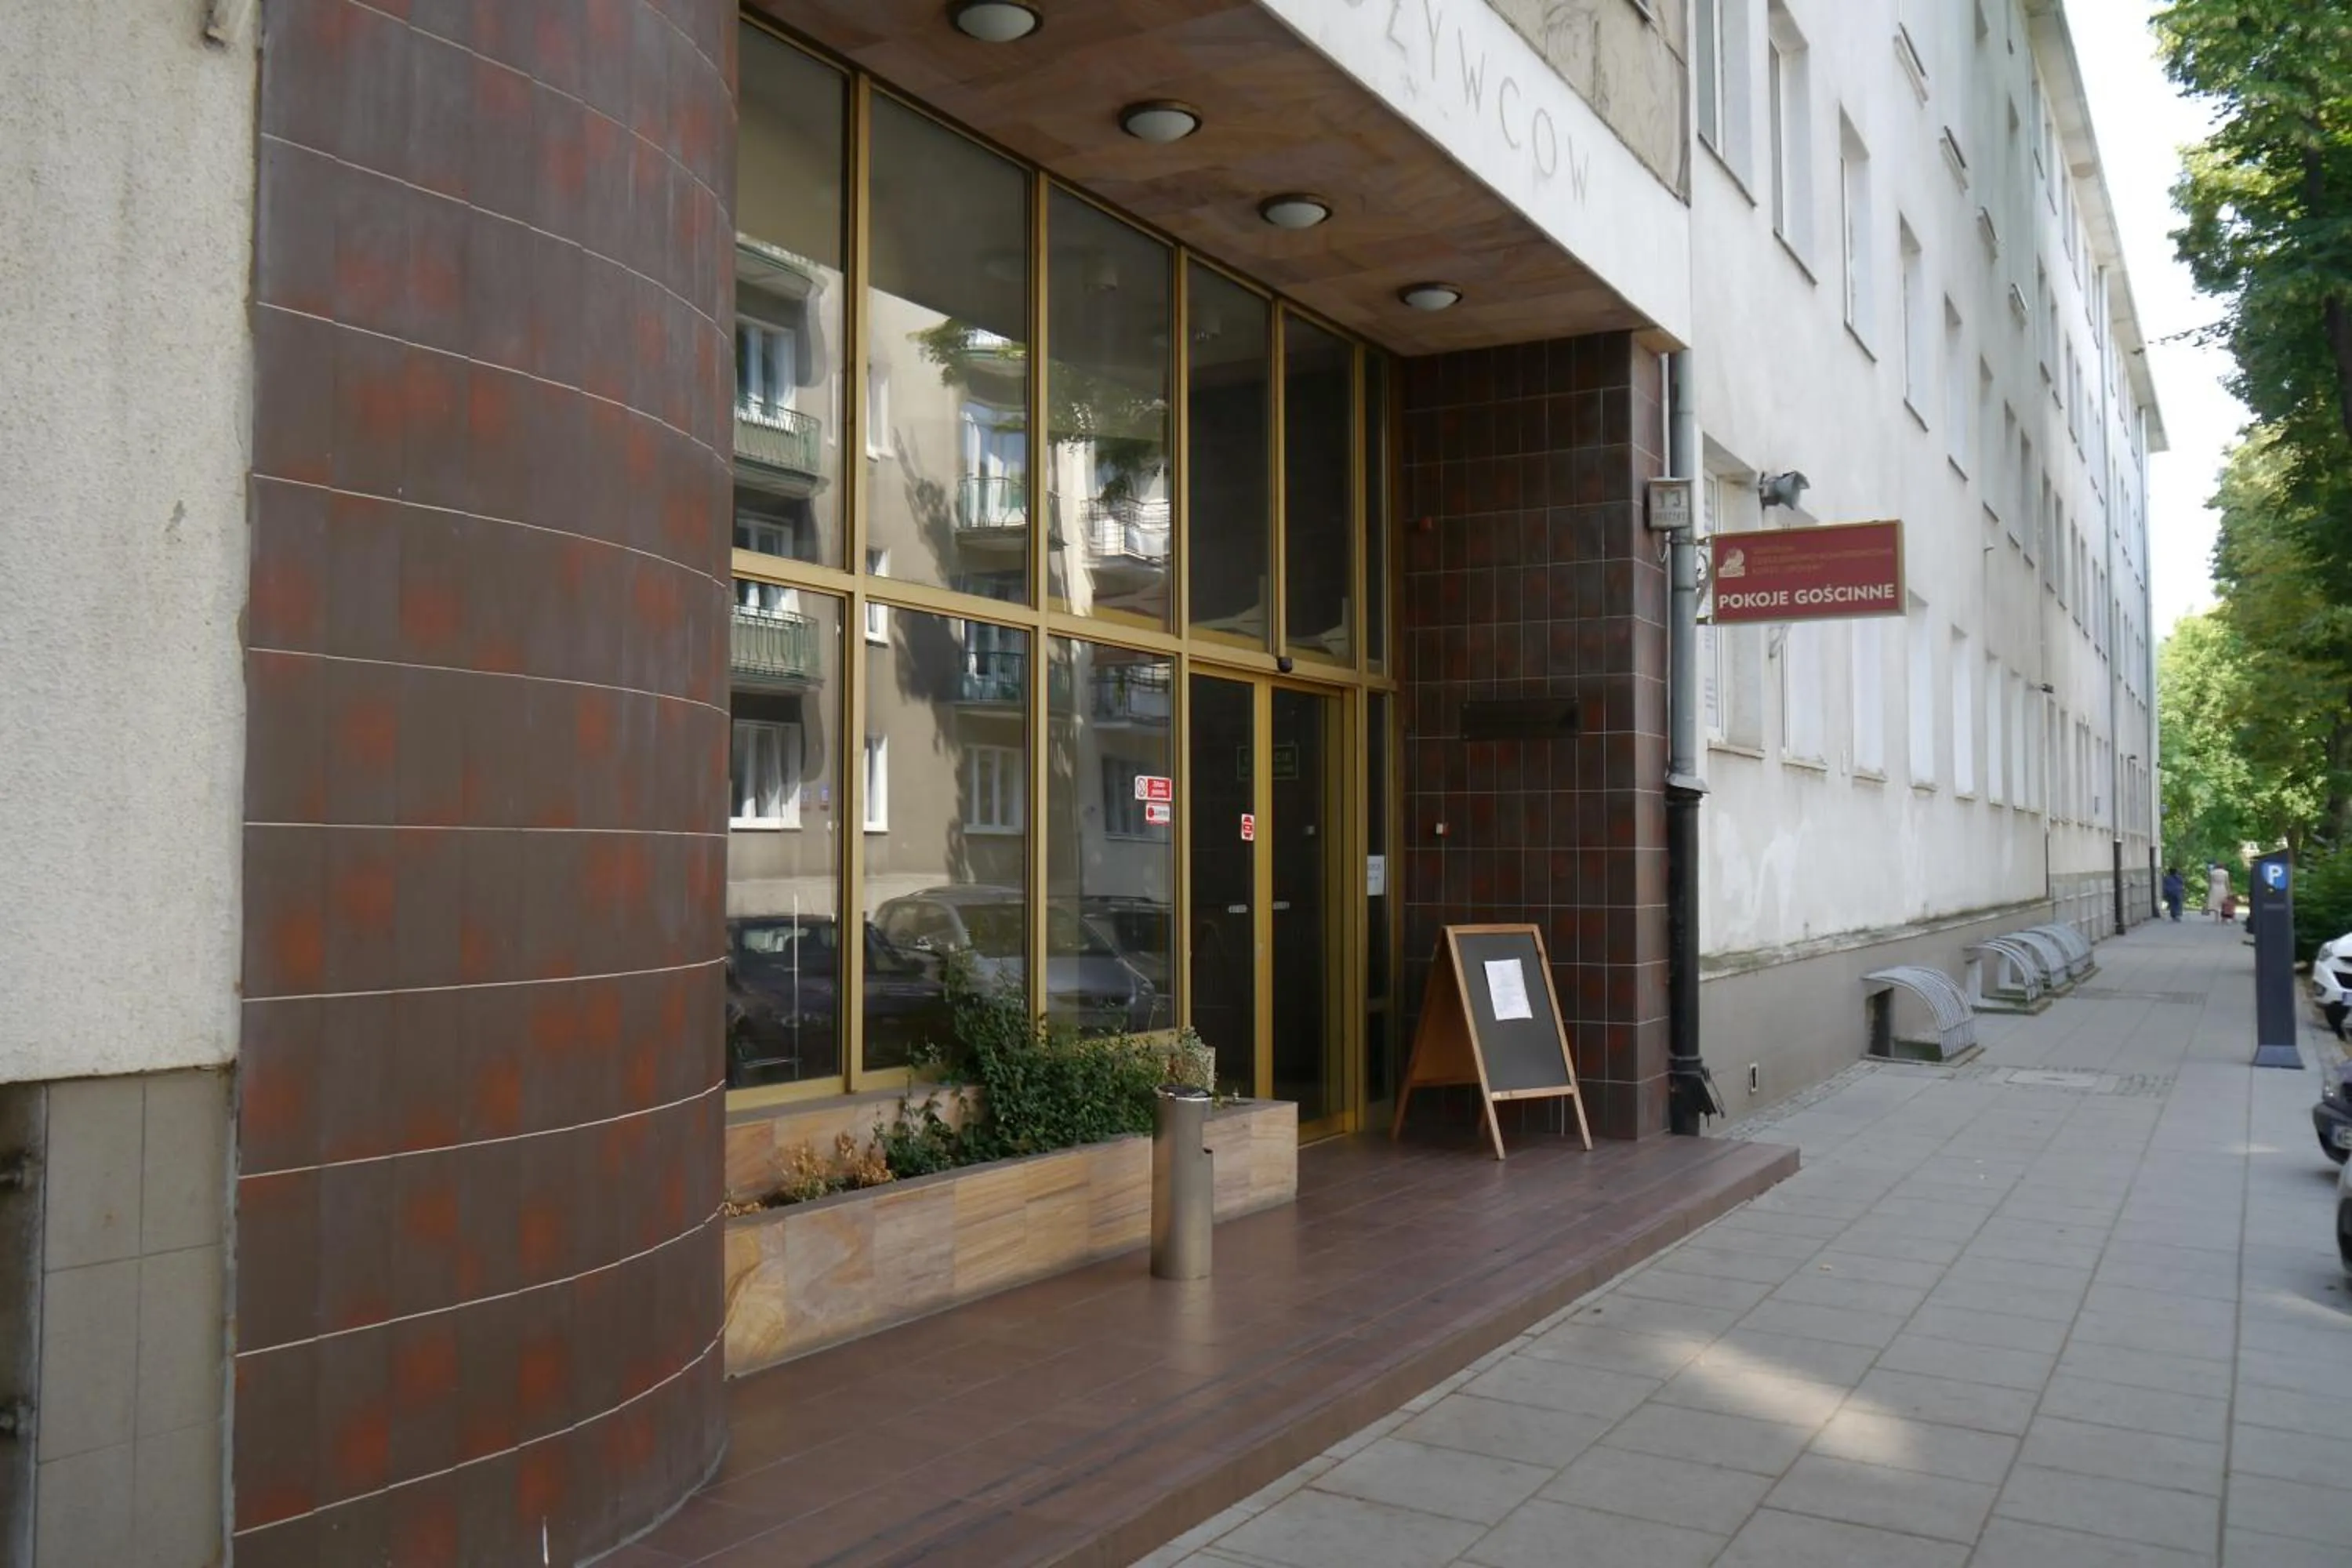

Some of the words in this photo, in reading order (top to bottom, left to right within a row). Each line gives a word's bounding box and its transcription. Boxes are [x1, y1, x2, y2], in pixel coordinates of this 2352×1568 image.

[1718, 590, 1789, 609] POKOJE
[1794, 583, 1895, 604] GOŚCINNE
[2268, 865, 2283, 886] P
